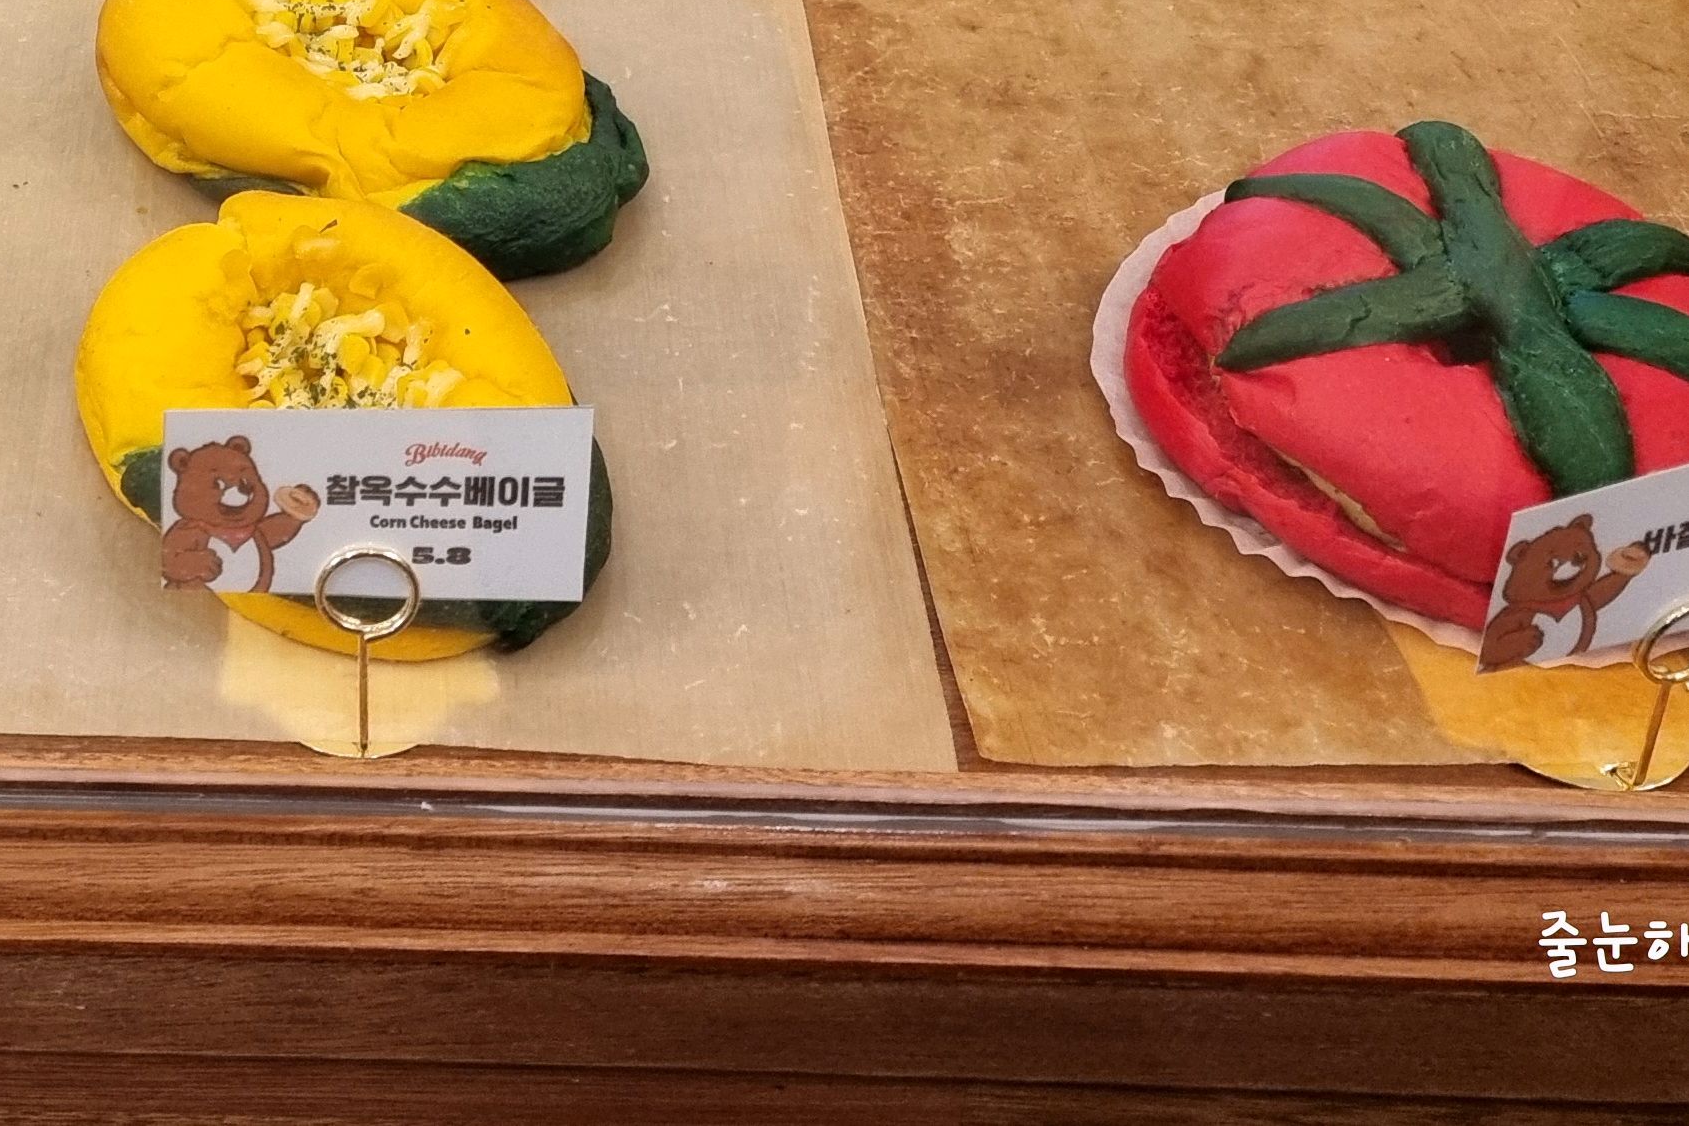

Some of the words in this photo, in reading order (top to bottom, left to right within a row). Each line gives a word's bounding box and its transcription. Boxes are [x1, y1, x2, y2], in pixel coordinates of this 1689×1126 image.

[404, 441, 489, 467] Bibidang
[325, 475, 567, 508] 찰옥수수베이글
[369, 514, 407, 529] Corn
[409, 514, 467, 530] Cheese
[472, 515, 519, 534] Bagel
[411, 545, 472, 565] 5.8
